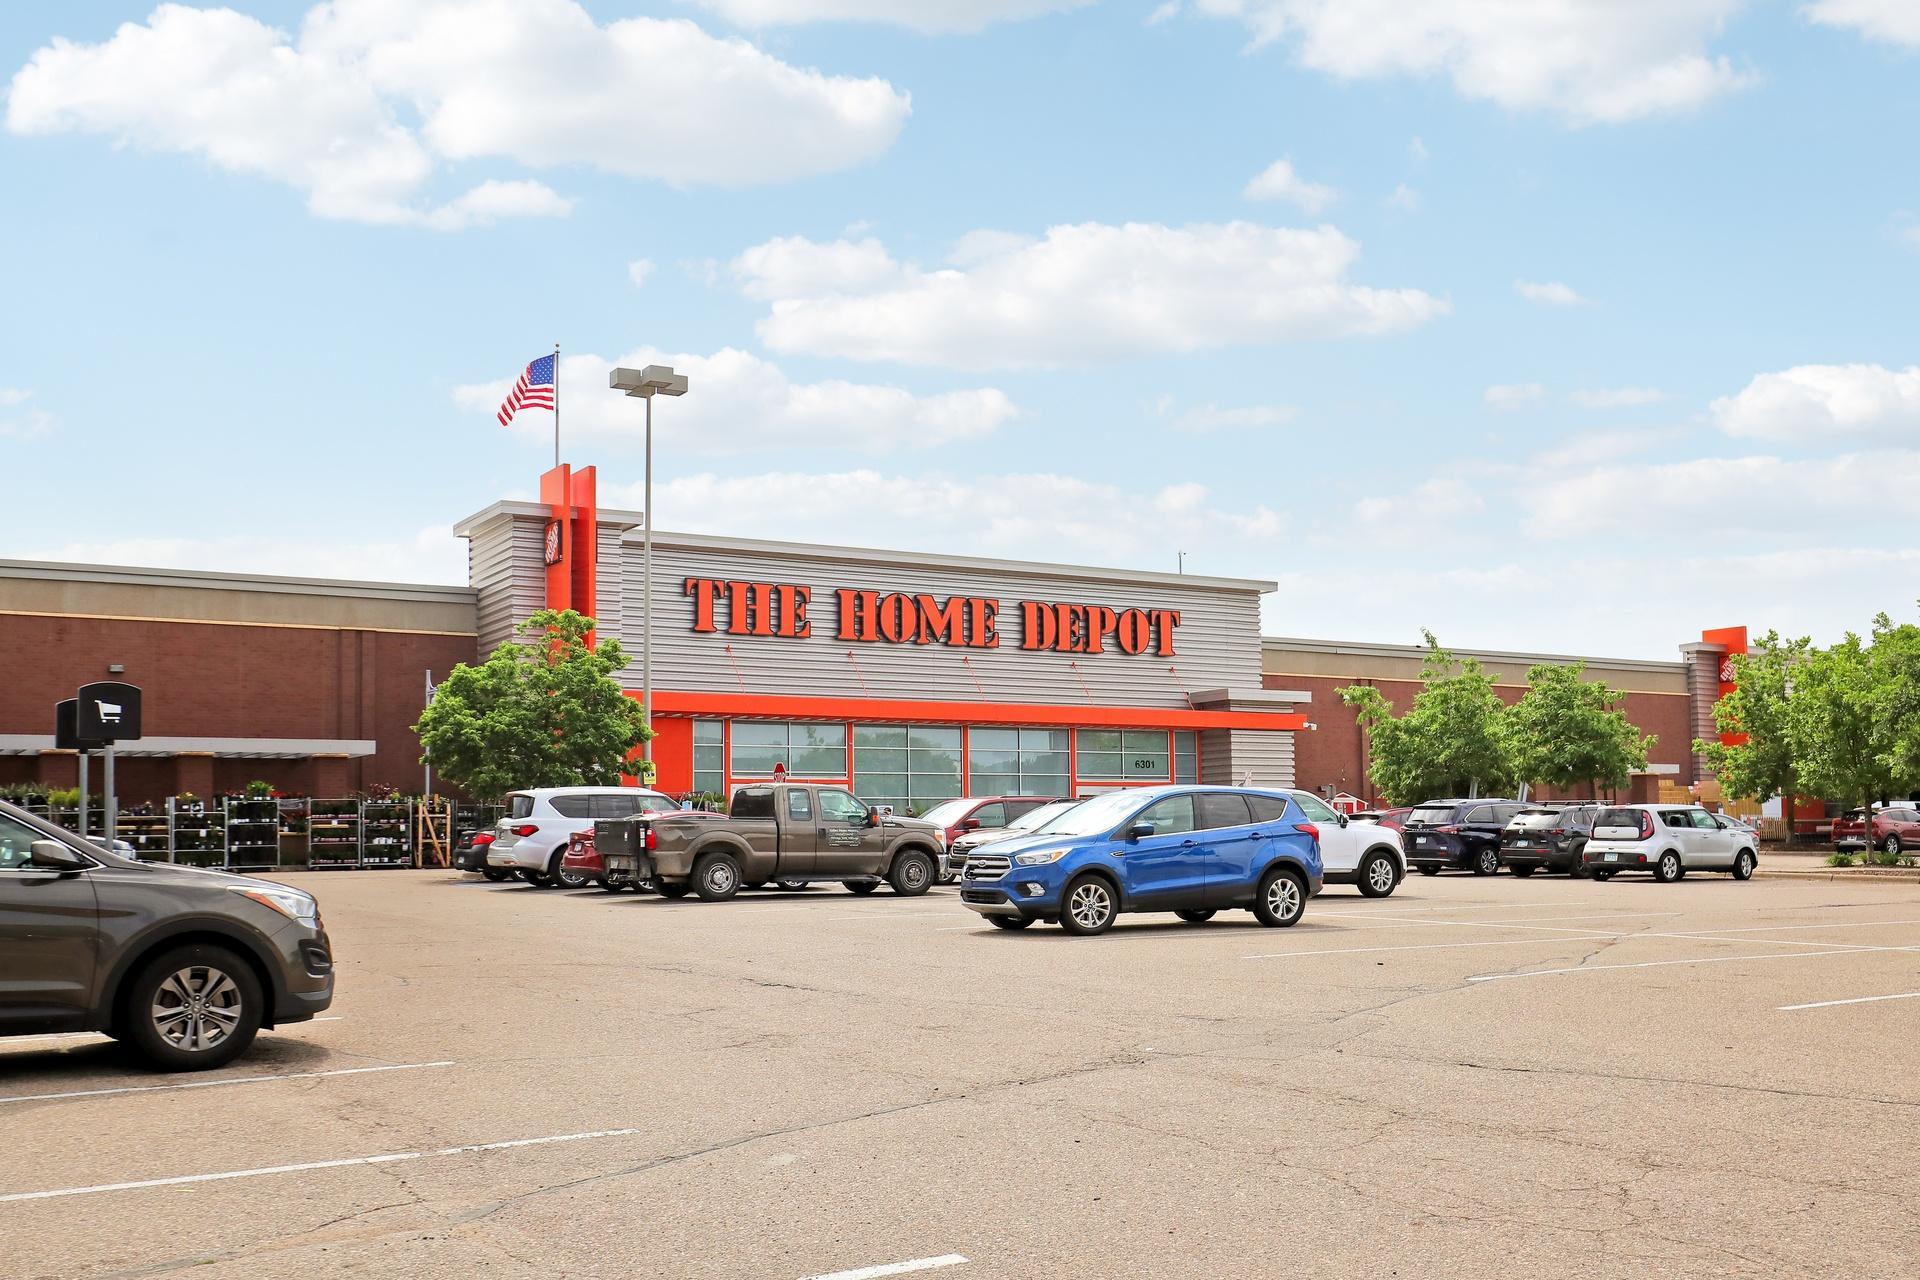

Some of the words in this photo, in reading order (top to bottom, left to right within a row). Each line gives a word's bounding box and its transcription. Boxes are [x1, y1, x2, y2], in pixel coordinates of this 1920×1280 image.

[684, 577, 812, 638] THE
[835, 588, 999, 648] HOME
[1020, 601, 1180, 657] DEPOT
[1135, 760, 1155, 769] 6301
[774, 772, 786, 783] STOP
